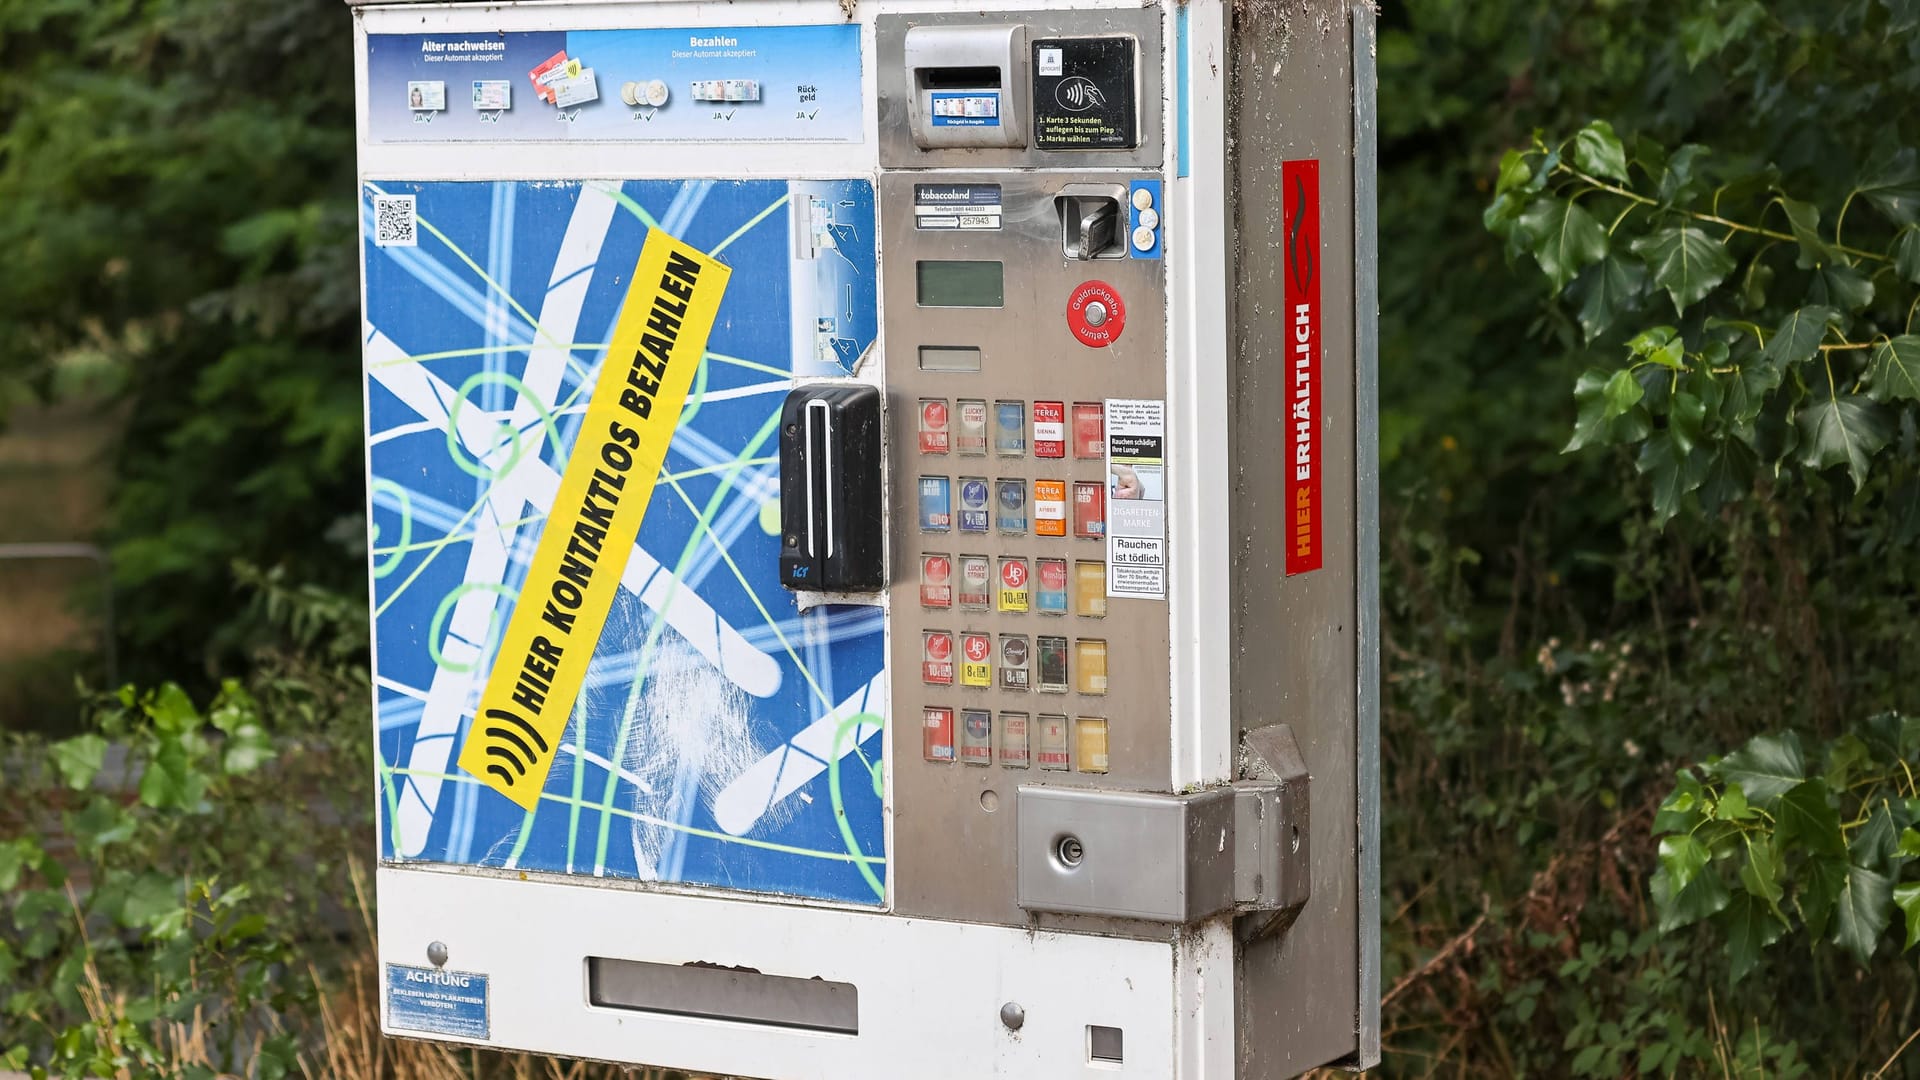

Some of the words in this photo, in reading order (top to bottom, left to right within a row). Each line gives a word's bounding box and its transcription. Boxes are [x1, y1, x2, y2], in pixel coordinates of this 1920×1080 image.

[422, 41, 446, 52] Alter
[447, 40, 505, 51] nachweisen
[690, 36, 737, 47] Bezahlen
[424, 54, 444, 62] Dieser
[444, 54, 471, 62] Automat
[472, 53, 503, 63] akzeptiert
[671, 49, 693, 58] Dieser
[694, 50, 721, 58] Automat
[723, 49, 757, 59] akzeptiert
[797, 85, 818, 94] Rück-
[799, 94, 816, 103] geld
[415, 113, 424, 122] JA
[481, 113, 489, 122] JA
[558, 112, 567, 121] JA
[633, 112, 643, 121] JA
[1046, 126, 1073, 134] auflegen
[1100, 126, 1114, 134] Piep
[921, 188, 970, 200] tobaccoland
[962, 216, 989, 225] 257943
[1072, 286, 1118, 316] Geldrückgabe
[1080, 327, 1109, 341] Return
[1293, 303, 1310, 482] ERHÄLTLICH
[1035, 409, 1059, 417] TEREA
[1111, 438, 1133, 446] Rauchen
[1134, 439, 1157, 448] schädigt
[1123, 446, 1139, 455] Lunge
[511, 635, 564, 716] HIER
[542, 421, 640, 637] KONTAKTLOS
[619, 250, 703, 421] BEZAHLEN
[1036, 487, 1060, 495] TEREA
[1077, 487, 1094, 495] L&M
[1077, 495, 1091, 503] RED
[1123, 519, 1152, 528] MARKE
[1297, 486, 1311, 557] HIER
[1117, 539, 1158, 550] Rauchen
[1115, 552, 1126, 561] ist
[1129, 552, 1160, 563] tödlich
[406, 971, 469, 988] ACHTUNG
[393, 988, 424, 998] BEKLEBEN
[441, 993, 483, 1005] PLAKATIEREN
[419, 1000, 453, 1009] VERBOTEN
